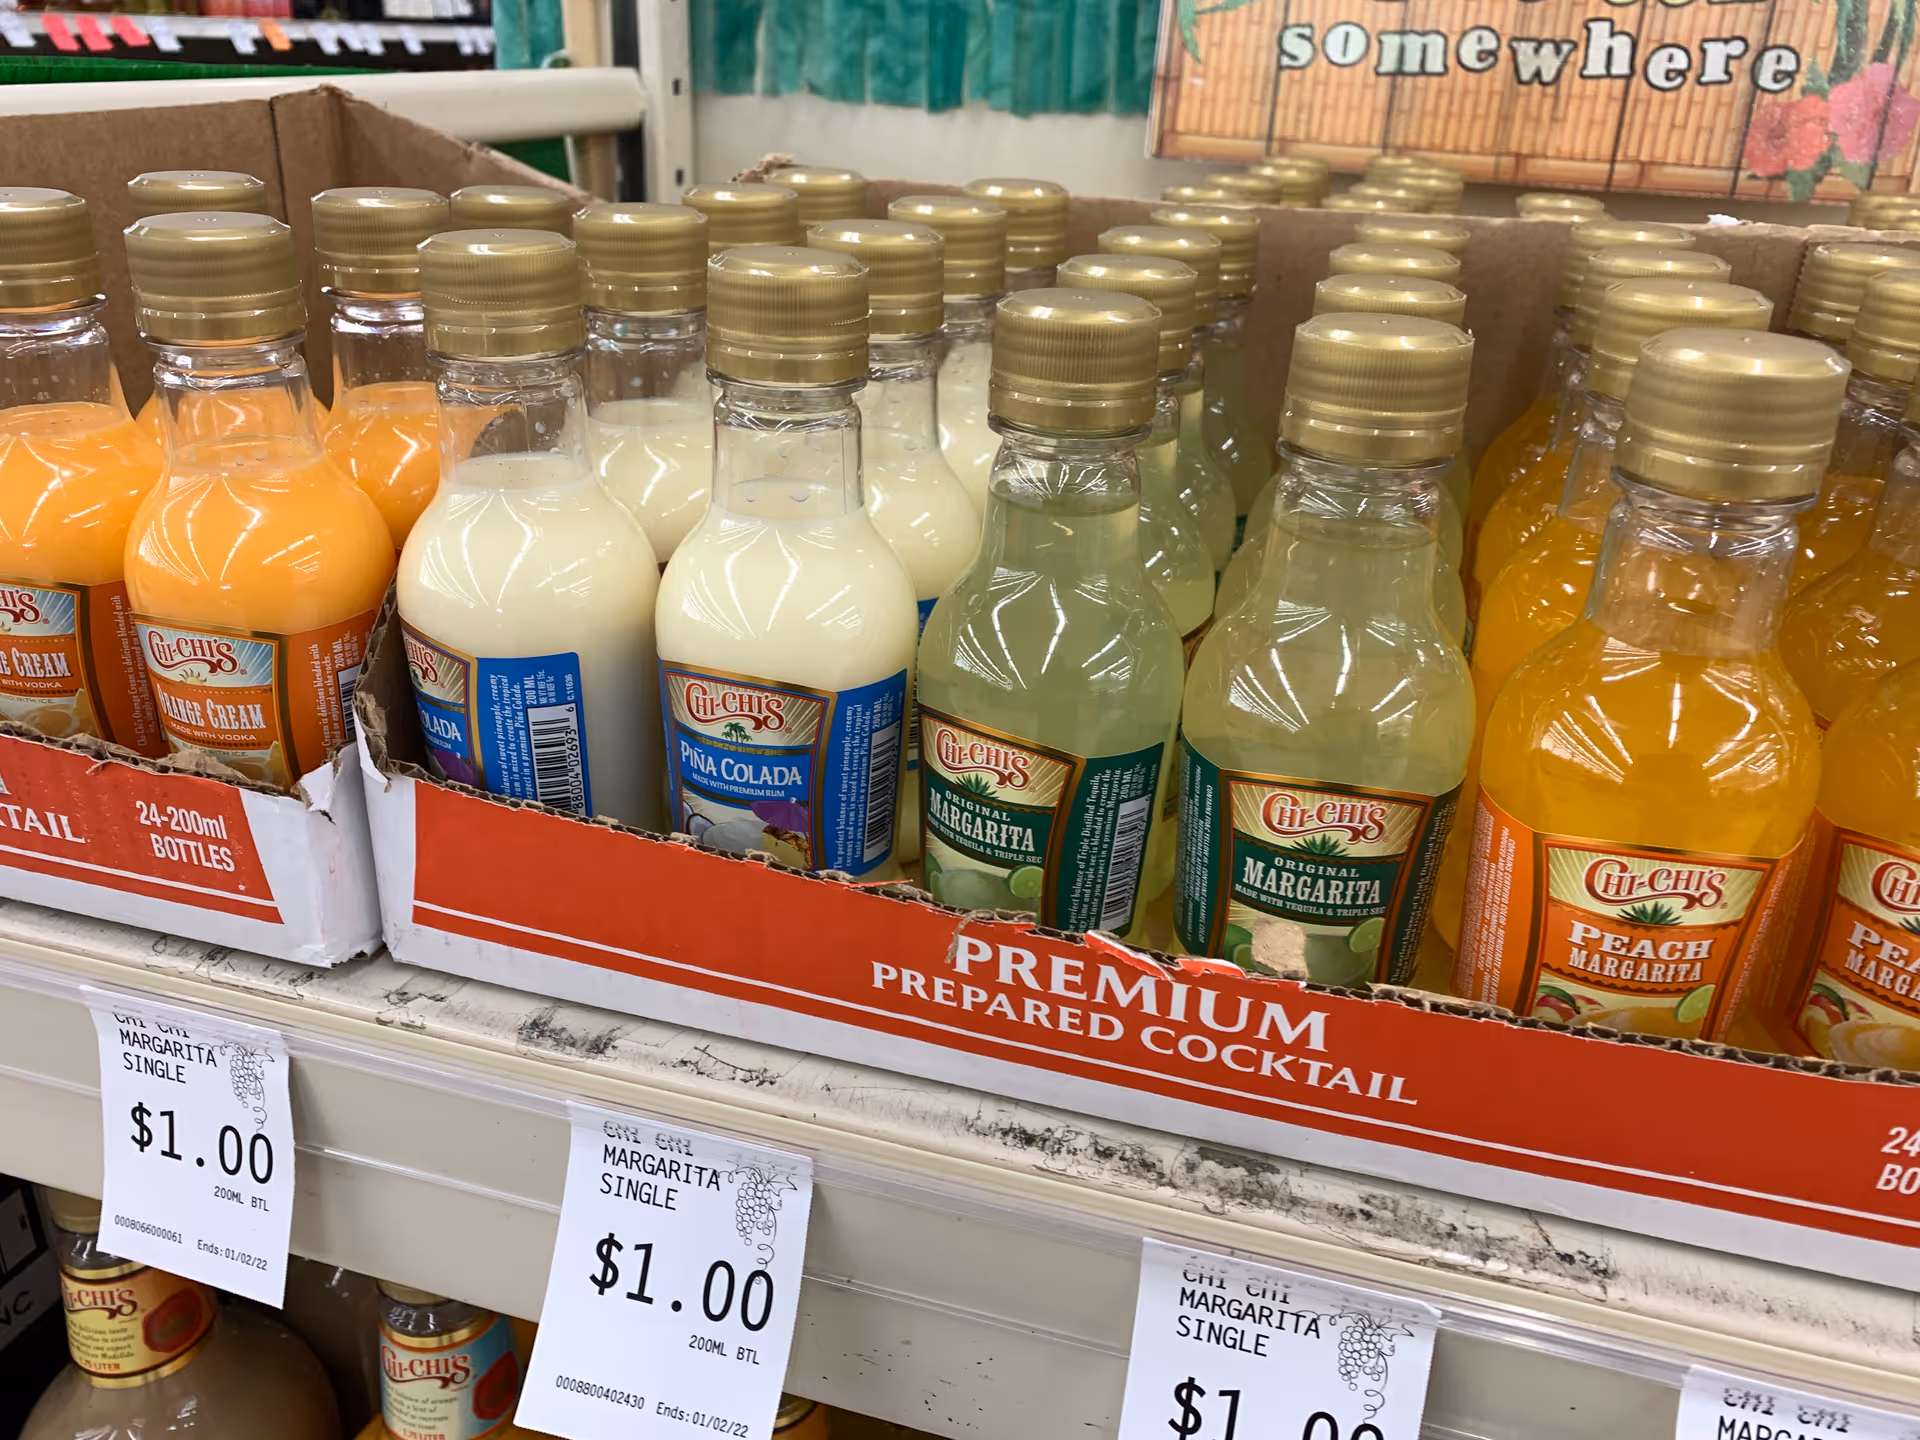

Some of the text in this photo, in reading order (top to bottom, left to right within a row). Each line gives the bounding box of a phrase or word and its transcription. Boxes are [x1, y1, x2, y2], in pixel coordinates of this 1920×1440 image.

[1279, 20, 1801, 92] somewhere
[11, 647, 72, 678] CREAM
[308, 644, 320, 659] with
[323, 653, 333, 674] rocks.
[332, 638, 345, 668] 200 ML
[25, 681, 63, 689] VODKA
[312, 661, 324, 687] blended
[324, 675, 334, 685] the
[489, 674, 500, 700] creamy
[316, 688, 327, 716] delicious
[498, 675, 511, 704] tropical
[510, 682, 523, 710] Colada.
[523, 675, 537, 705] 200 ML
[157, 683, 267, 731] ORANGE CREAM
[327, 696, 340, 721] enjoyed
[491, 702, 506, 739] pineapple,
[502, 706, 512, 717] the
[515, 712, 525, 728] Piña
[845, 706, 854, 732] creamy
[872, 698, 883, 728] 200 ML
[170, 721, 257, 741] MADE WITH VODKA
[321, 725, 330, 746] Cream
[505, 719, 515, 741] create
[496, 741, 506, 760] sweet
[518, 730, 530, 761] premium
[565, 729, 580, 766] 02693
[842, 733, 852, 771] pineapple,
[508, 751, 519, 772] mixed
[680, 740, 718, 777] PIÑA
[720, 757, 803, 786] COLADA
[1101, 769, 1112, 781] the
[523, 776, 534, 799] expect
[571, 772, 584, 809] 88004
[709, 780, 729, 790] WITH
[729, 786, 766, 797] PREMIUM
[765, 789, 785, 797] RUM
[841, 773, 849, 792] sweet
[1087, 772, 1102, 803] Tequila,
[1099, 783, 1110, 807] create
[1107, 767, 1122, 808] Margarita.
[1119, 768, 1133, 800] 200 ML
[136, 800, 228, 840] 24-200ml
[837, 803, 847, 829] balance
[930, 787, 1035, 852] MARGARITA
[945, 790, 1011, 821] ORIGINAL
[0, 803, 86, 844] TAIL
[1081, 805, 1096, 837] Distilled
[1090, 817, 1104, 845] blended
[1102, 810, 1114, 842] premium
[150, 833, 235, 872] BOTTLES
[836, 831, 846, 855] perfect
[955, 835, 985, 854] TEQUILA
[985, 848, 993, 856] &
[994, 849, 1025, 861] TRIPLE
[1026, 855, 1043, 864] SEC
[1077, 838, 1091, 859] Triple
[834, 856, 843, 869] The
[1089, 854, 1097, 866] sec
[1096, 859, 1106, 882] expect
[1274, 857, 1360, 877] ORIGINAL
[1071, 870, 1085, 898] balance
[1083, 868, 1095, 887] triple
[1093, 884, 1102, 896] you
[1242, 856, 1381, 905] MARGARITA
[1082, 889, 1091, 902] and
[1089, 897, 1097, 915] taste
[1235, 883, 1386, 917] MADE WITH TEQUILA & TRIPLE SEC
[1069, 899, 1081, 924] perfect
[1080, 904, 1089, 918] lime
[1567, 920, 1714, 960] PEACH
[1568, 947, 1702, 983] MARGARITA
[1845, 949, 1920, 1001] MARGA
[952, 934, 1330, 1053] PREMIUM
[871, 960, 1418, 1105] PREPARED COCKTAIL
[120, 1029, 217, 1067] MARGARITA
[124, 1053, 186, 1083] SINGLE
[130, 1102, 274, 1184] $1.00
[603, 1144, 720, 1191] MARGARITA
[214, 1186, 270, 1212] 200ML BTL
[600, 1173, 678, 1210] SINGLE
[114, 1214, 183, 1244] 0008066000061
[589, 1233, 774, 1331] $1.00
[1179, 1287, 1320, 1339] MARGARITA
[689, 1335, 760, 1365] 200ML BTL
[1176, 1315, 1270, 1357] SINGLE
[555, 1375, 645, 1410] 0008800402430
